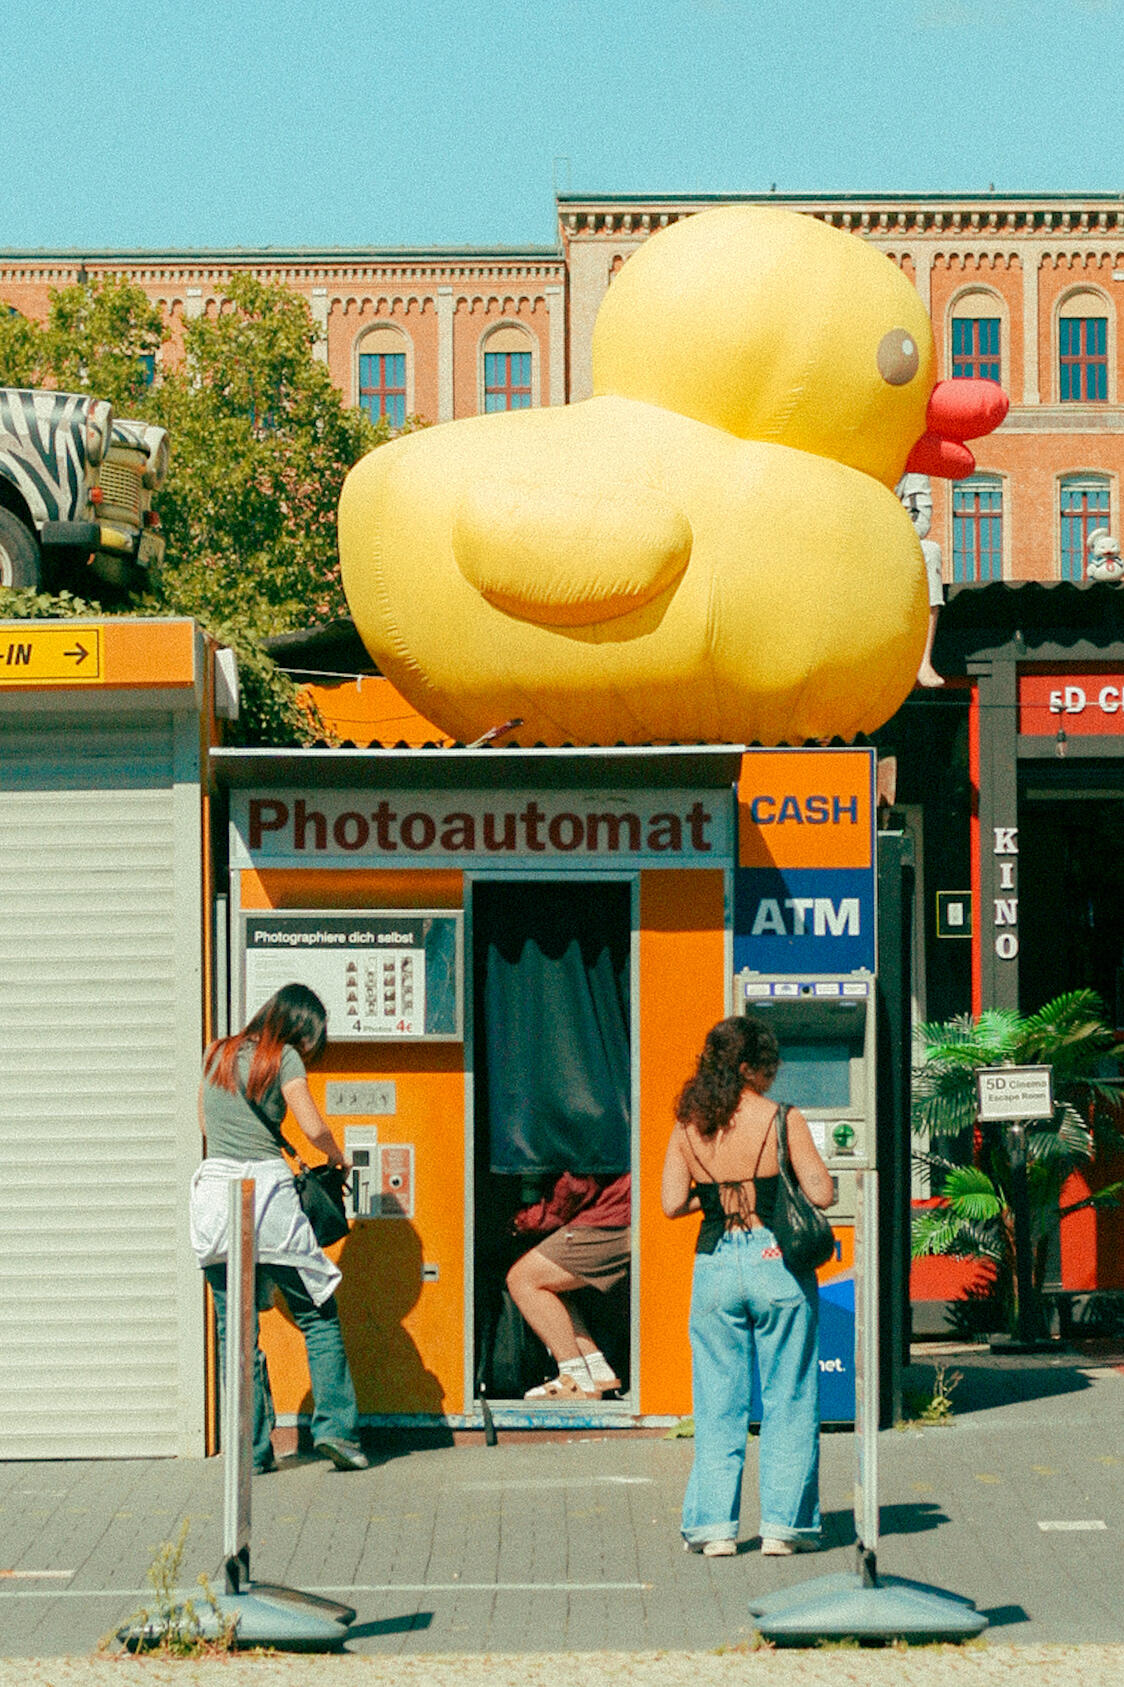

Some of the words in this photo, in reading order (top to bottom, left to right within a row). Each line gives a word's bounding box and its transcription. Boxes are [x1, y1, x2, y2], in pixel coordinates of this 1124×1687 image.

[1049, 686, 1086, 713] 5D
[750, 795, 858, 824] CASH
[248, 799, 712, 852] Photoautomat
[993, 827, 1019, 960] KINO
[751, 898, 860, 936] ATM
[254, 931, 346, 945] Photographiere
[349, 931, 375, 943] dich
[378, 931, 414, 943] selbst
[352, 1020, 361, 1032] 4
[986, 1078, 1006, 1090] 5D
[988, 1094, 1020, 1102] Escape
